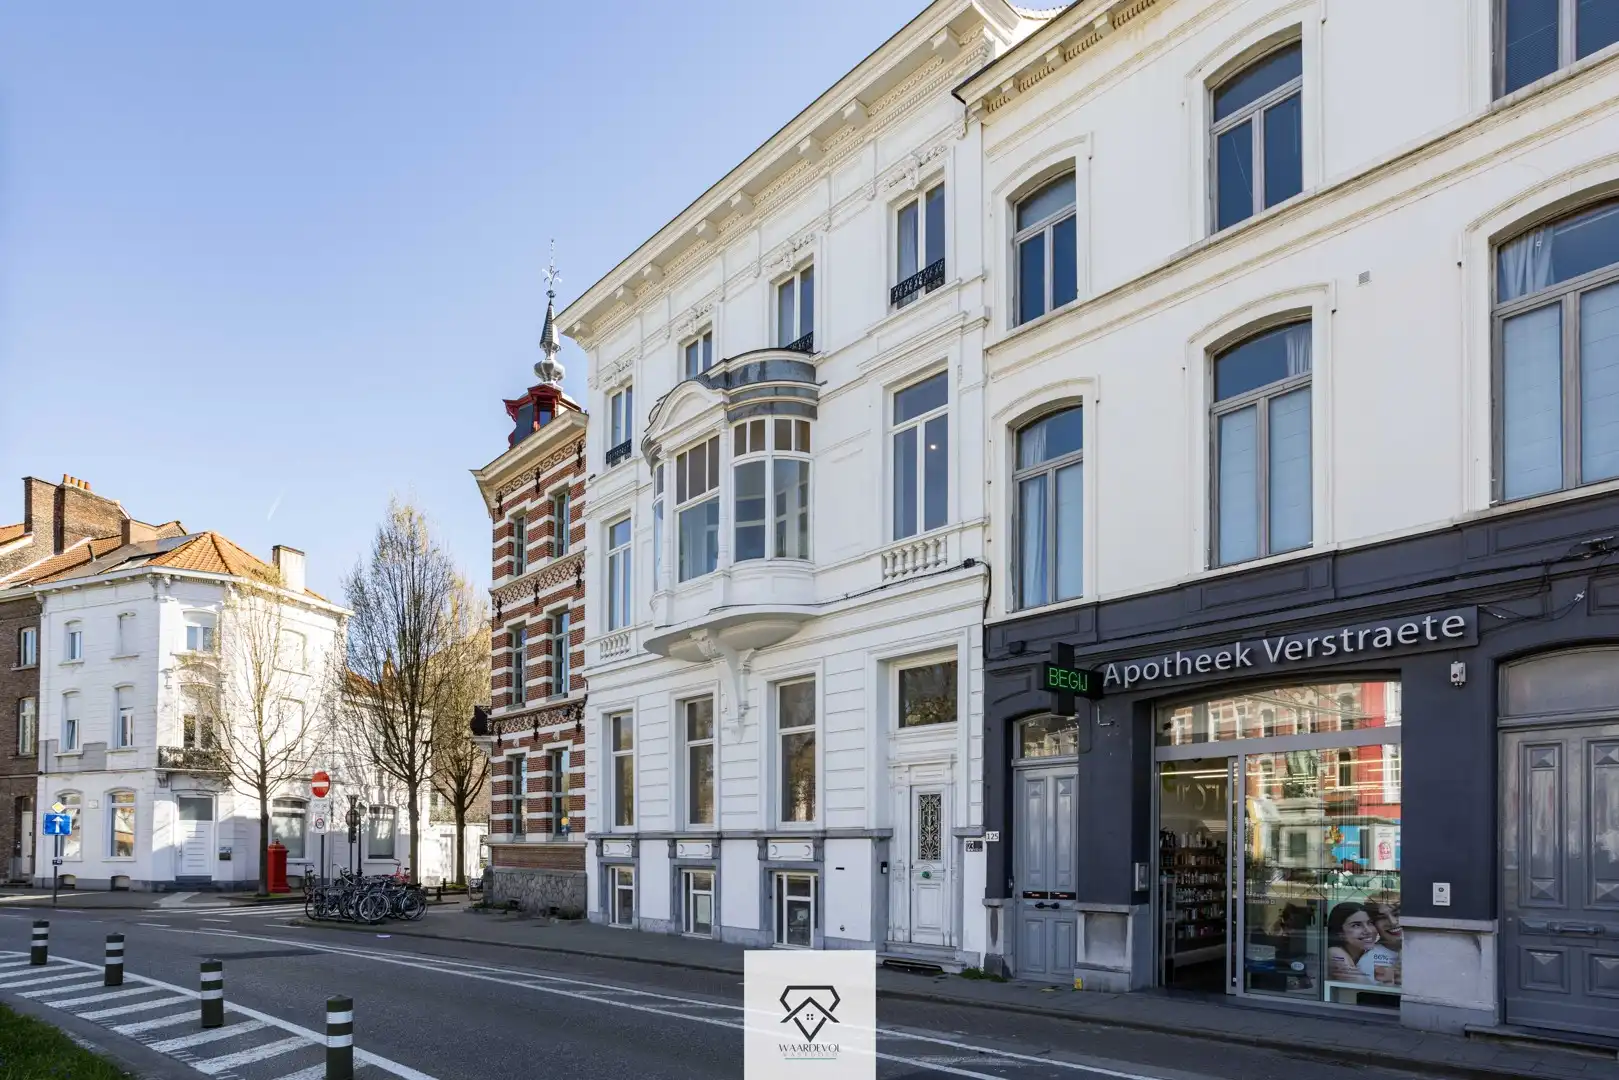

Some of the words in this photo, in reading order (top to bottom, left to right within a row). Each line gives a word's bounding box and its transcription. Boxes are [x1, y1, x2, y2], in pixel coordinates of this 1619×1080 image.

[1103, 641, 1253, 689] Apotheek
[1263, 614, 1466, 663] Verstraete
[1049, 667, 1088, 691] BEGIJ
[986, 832, 999, 840] 125
